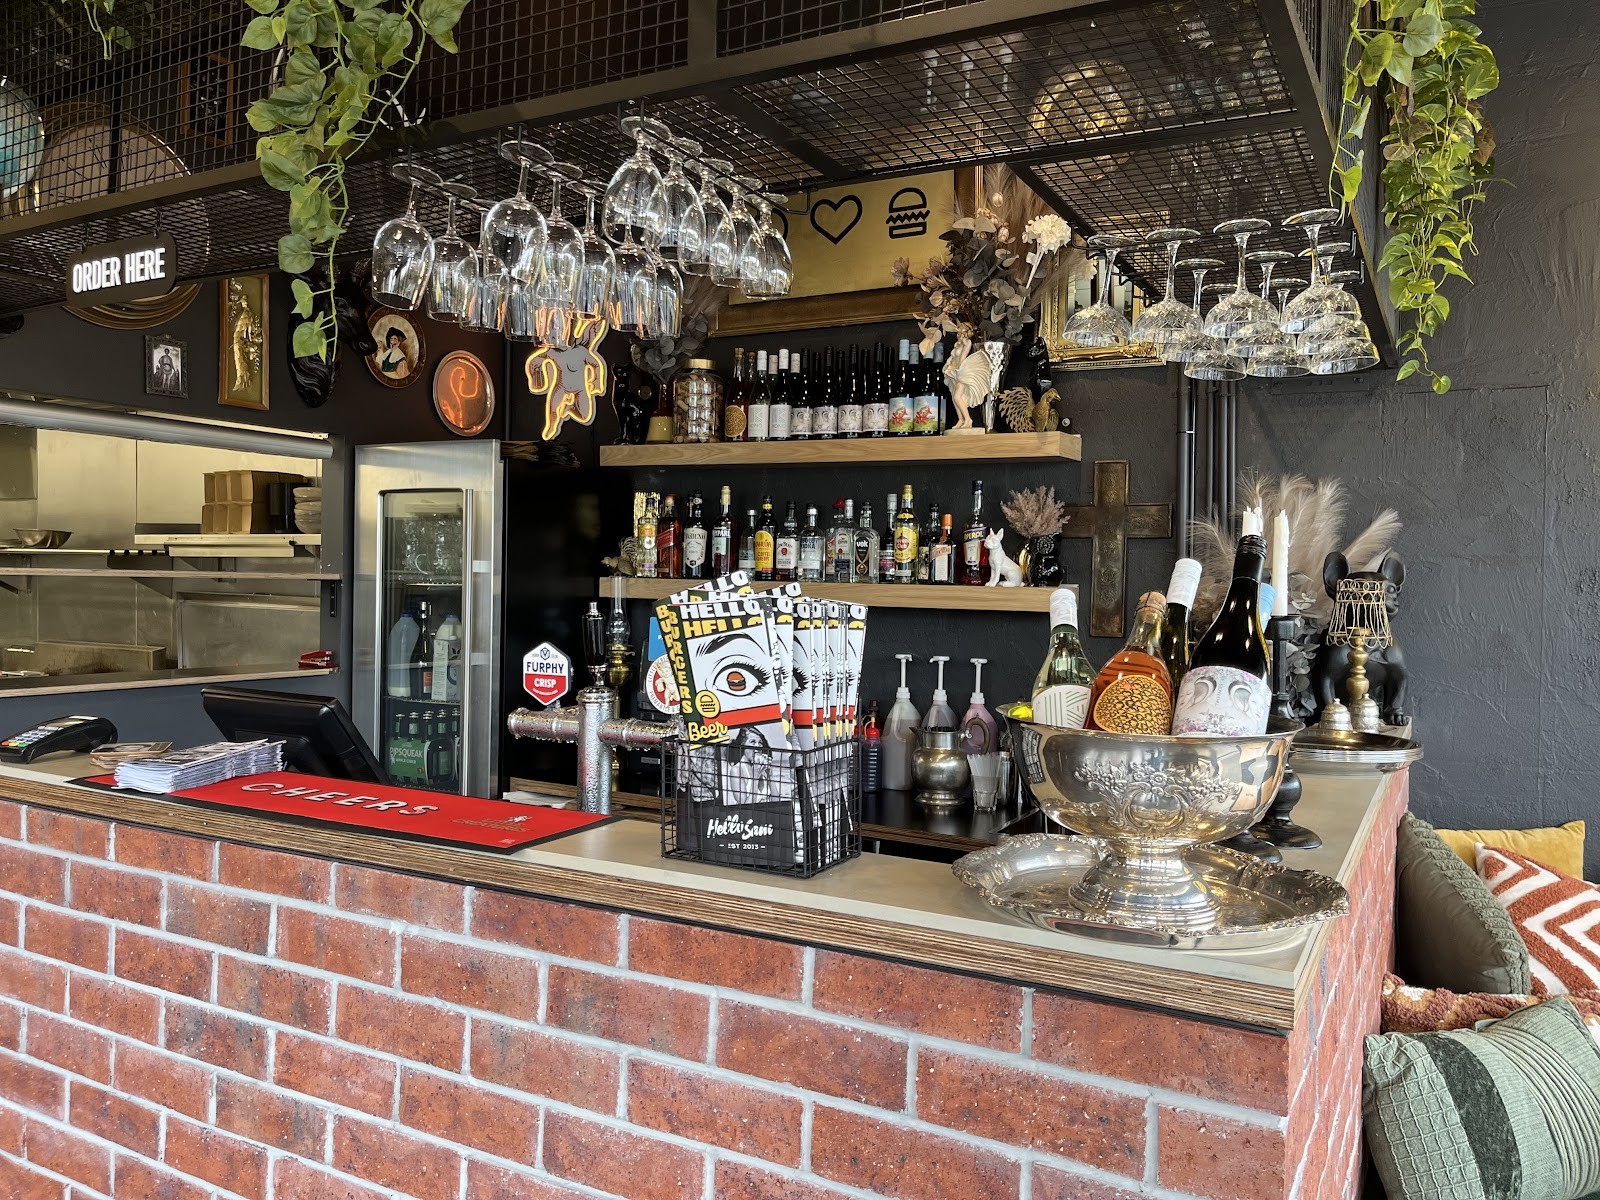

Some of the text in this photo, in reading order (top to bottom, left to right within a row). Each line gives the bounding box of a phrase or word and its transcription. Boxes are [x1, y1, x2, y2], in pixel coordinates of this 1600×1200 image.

[72, 247, 166, 294] ORDER HERE
[680, 599, 761, 620] HELLO
[526, 661, 565, 674] FURPHY
[668, 610, 694, 715] BURGERS
[533, 677, 557, 688] CRISP
[687, 720, 729, 742] Beer
[389, 746, 424, 759] PIPSQUEAK
[241, 783, 438, 815] CHEERS
